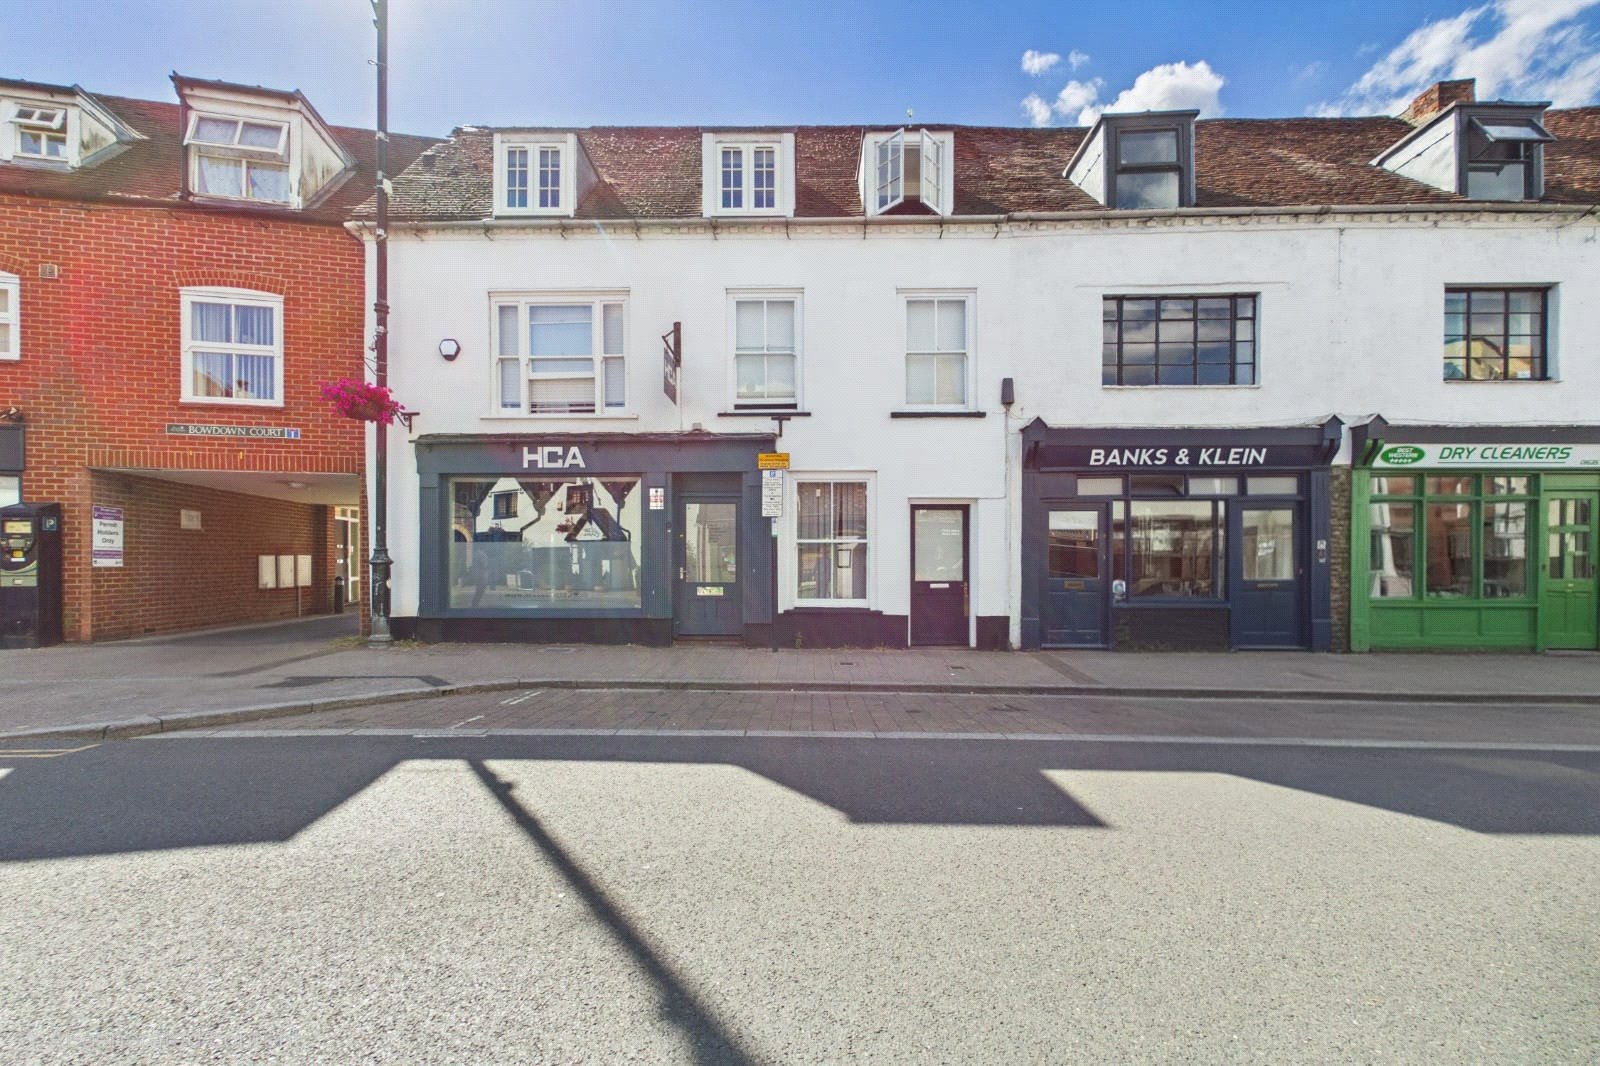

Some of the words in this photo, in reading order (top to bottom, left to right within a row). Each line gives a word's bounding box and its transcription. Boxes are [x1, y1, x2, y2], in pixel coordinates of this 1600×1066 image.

[188, 425, 246, 436] BOWDOWN
[249, 427, 283, 437] COURT
[522, 446, 586, 468] HCA
[1089, 448, 1168, 466] BANKS
[1174, 448, 1190, 465] &
[1198, 448, 1267, 465] KLEIN
[1439, 447, 1475, 459] DRY
[1480, 447, 1572, 459] CLEANERS
